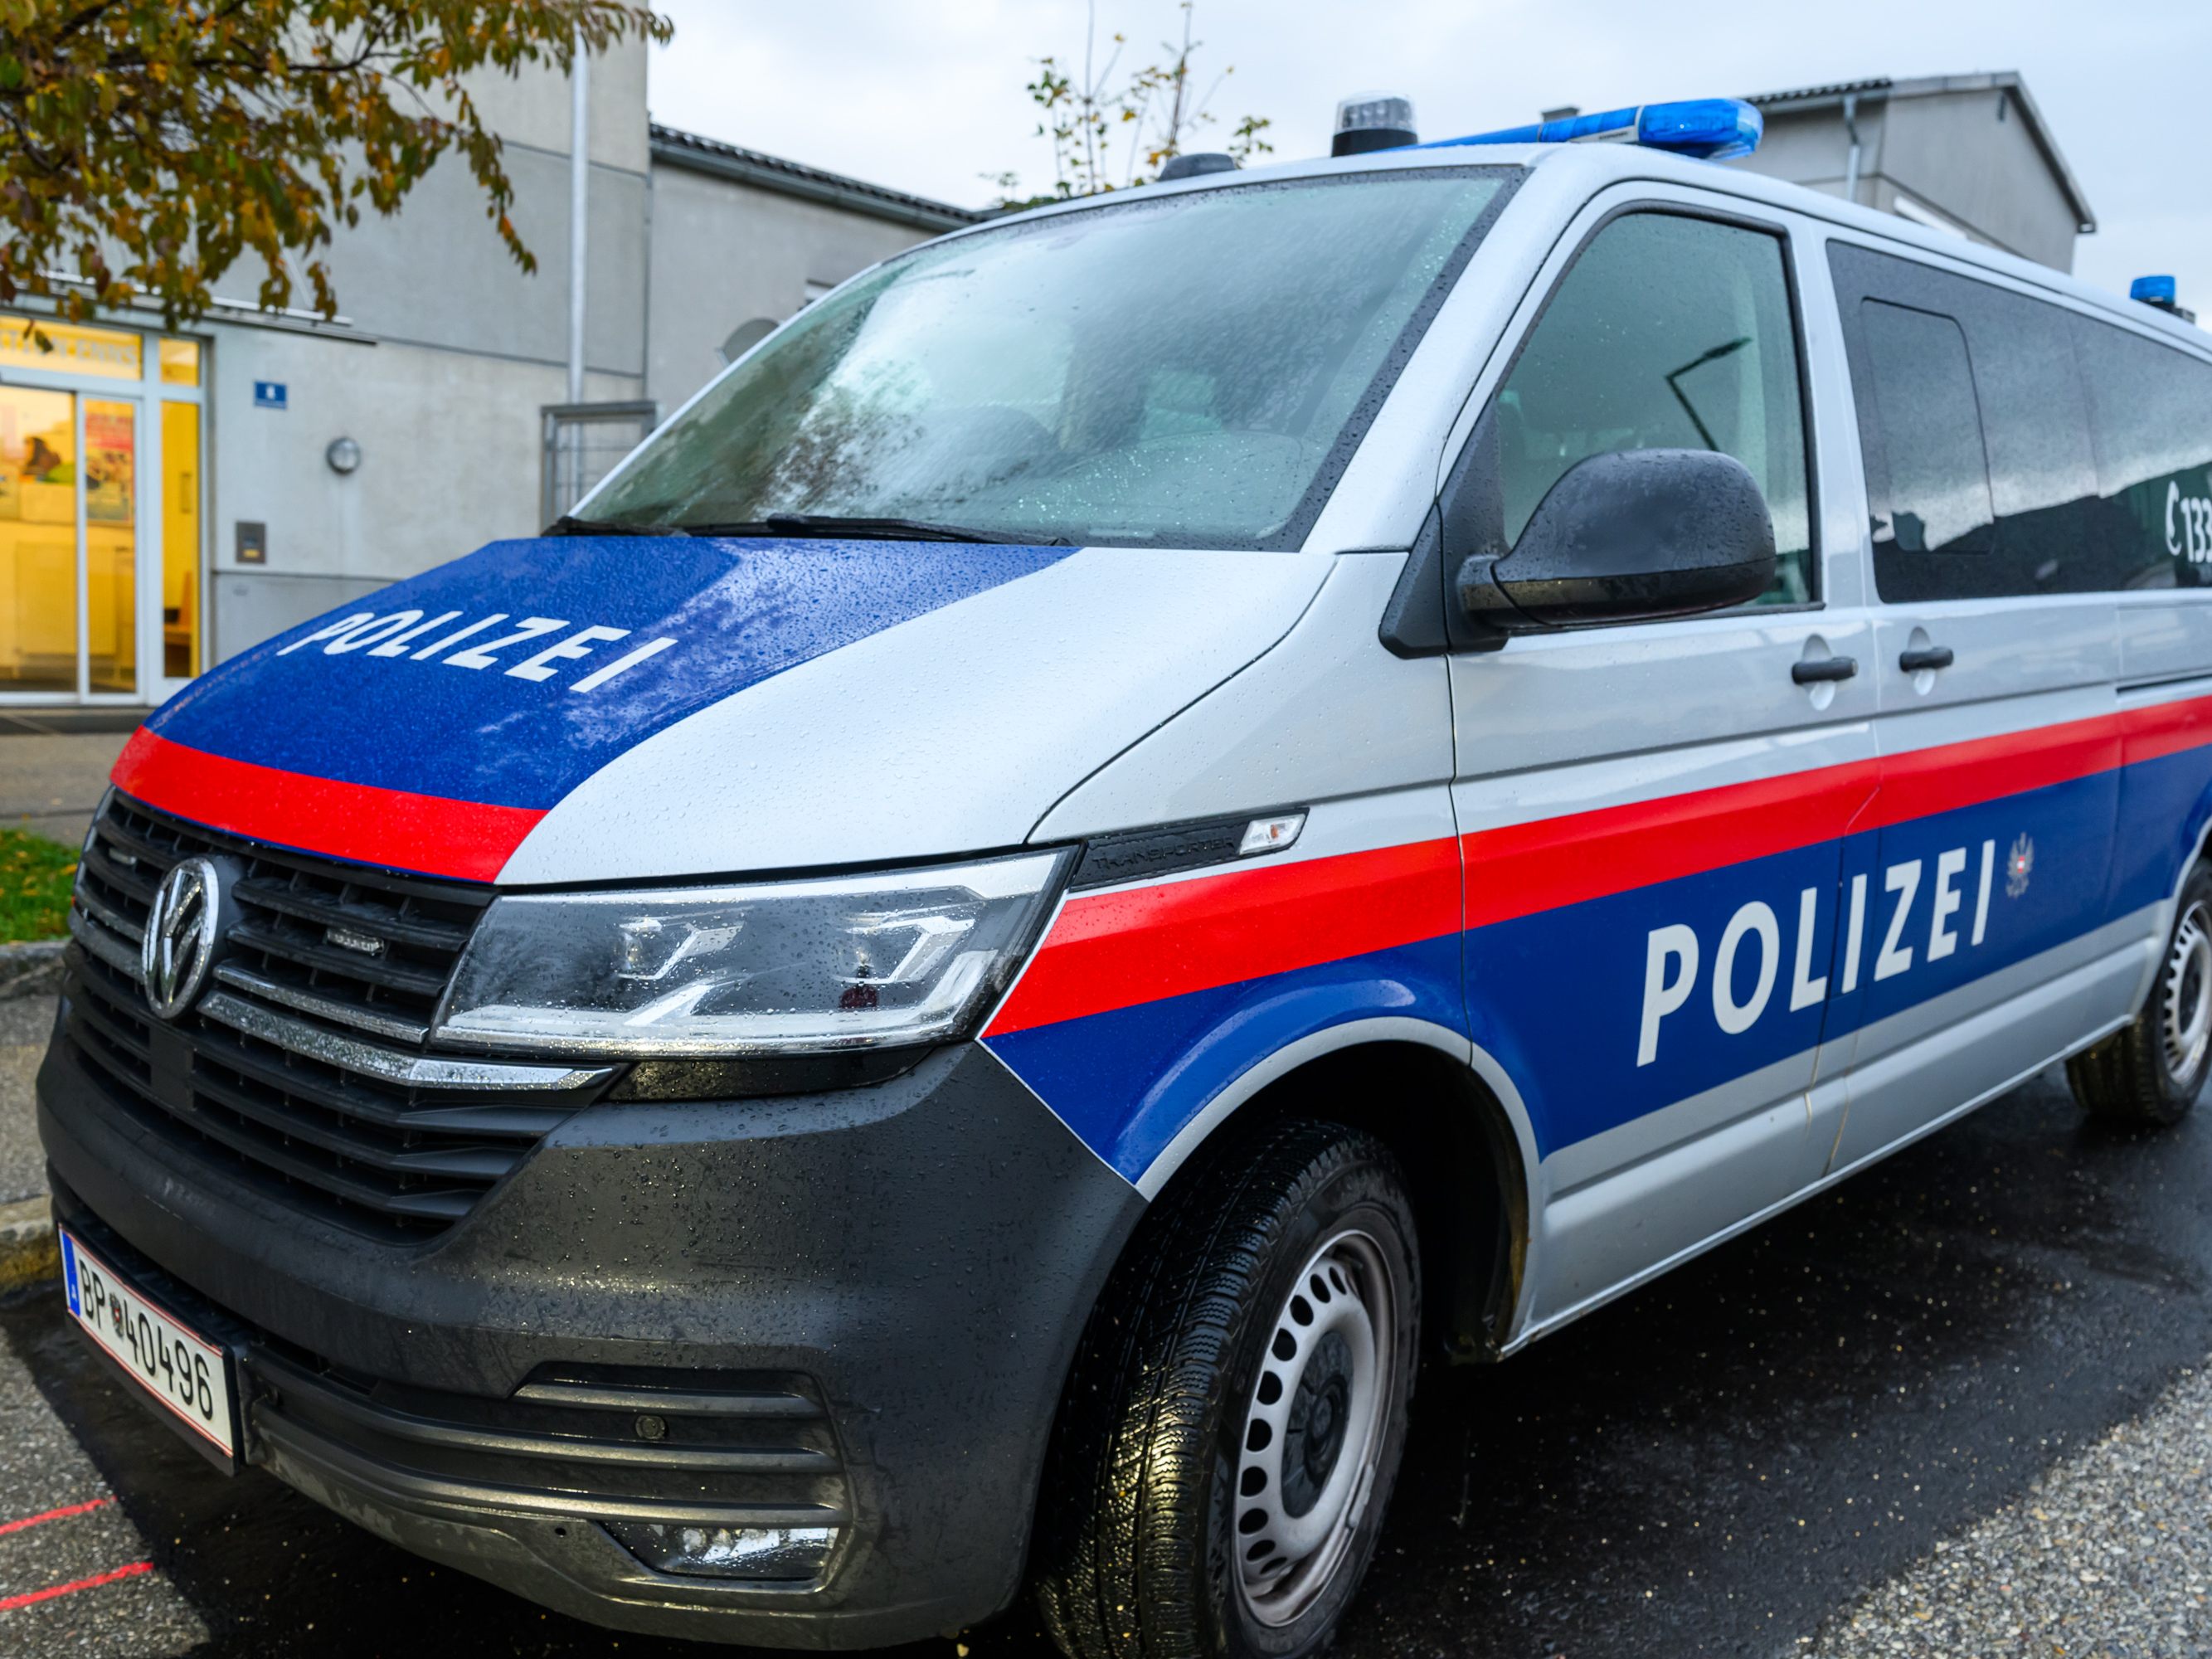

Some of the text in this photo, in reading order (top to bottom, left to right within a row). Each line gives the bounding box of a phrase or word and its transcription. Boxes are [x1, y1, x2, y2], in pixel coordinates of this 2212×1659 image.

[276, 610, 678, 693] POLIZEI
[1091, 836, 1237, 870] TRANSPORTER
[1637, 839, 1996, 1068] POLIZEI
[79, 1258, 214, 1421] BP 40496
